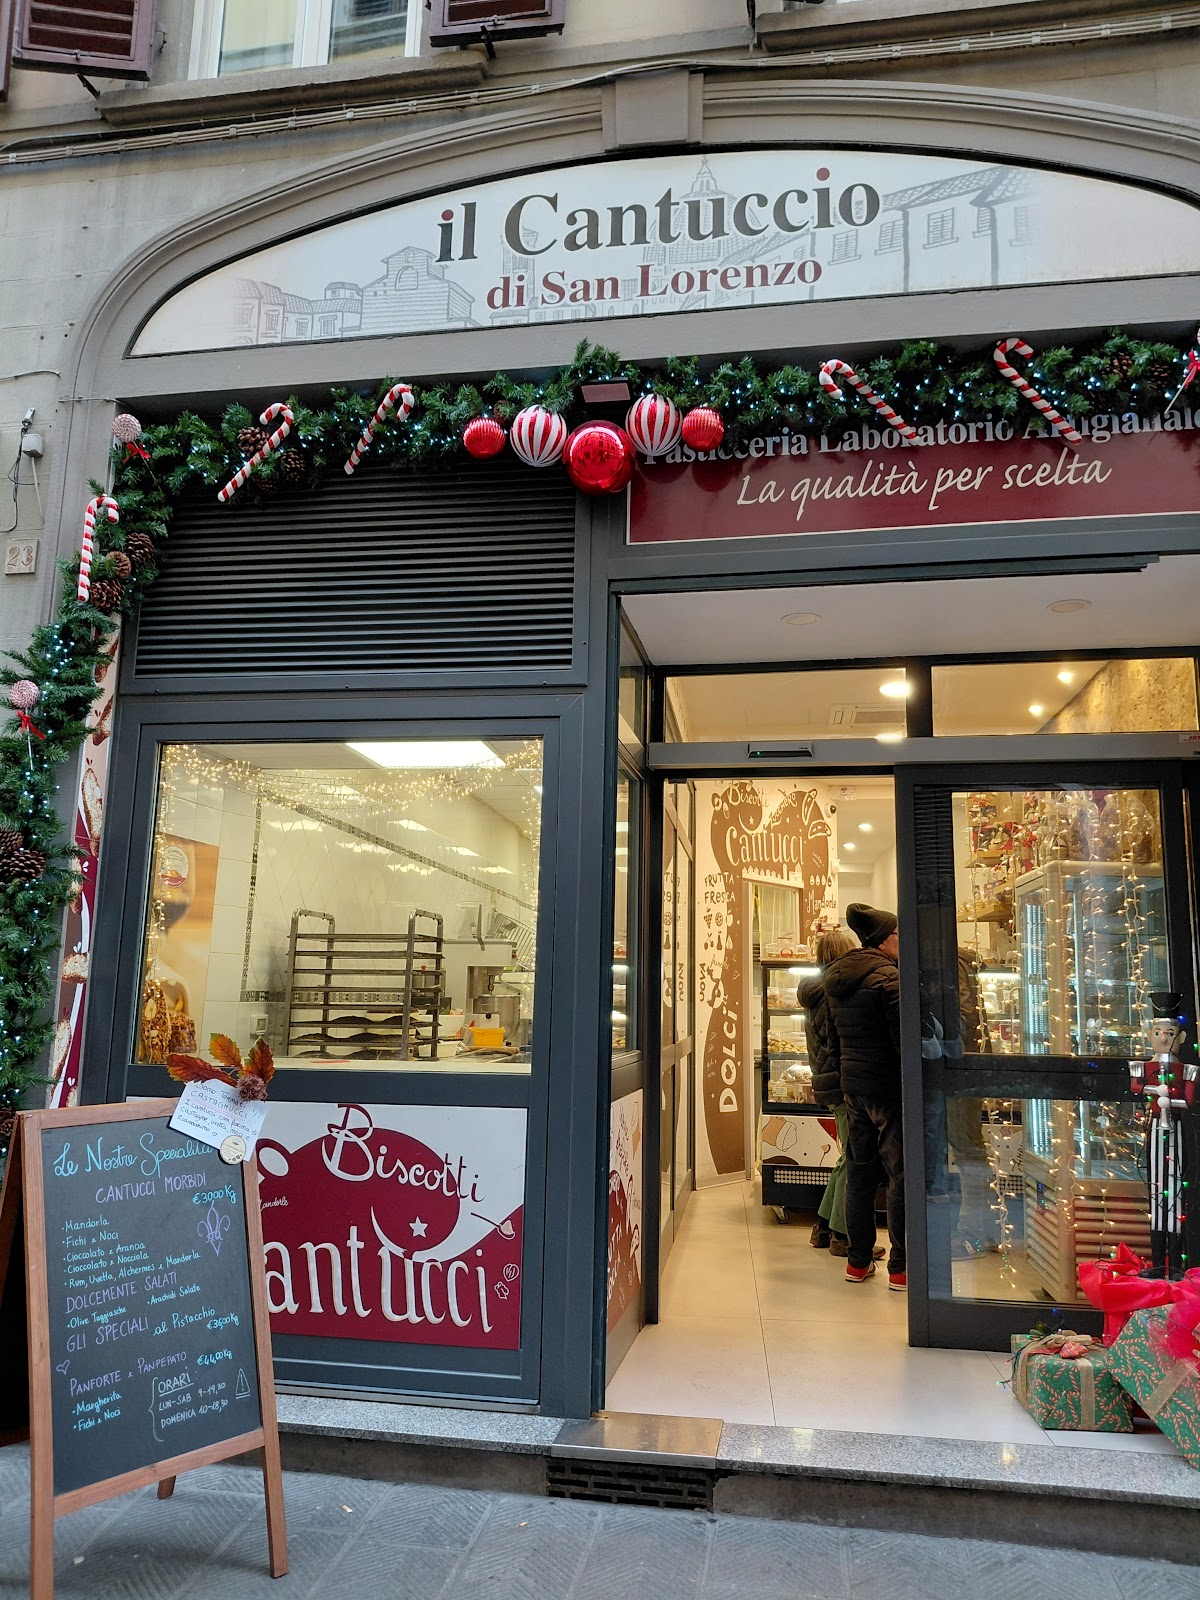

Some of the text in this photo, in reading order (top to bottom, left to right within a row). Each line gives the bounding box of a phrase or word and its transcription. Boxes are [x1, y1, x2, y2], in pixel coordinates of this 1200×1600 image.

[435, 167, 881, 263] il Cantuccio
[486, 259, 823, 310] di San Lorenzo
[736, 446, 1112, 521] La qualità per scelta
[7, 545, 33, 567] 23
[725, 824, 804, 866] Cantucci
[704, 872, 735, 888] FRUTTA
[806, 888, 837, 914] Mandorle
[719, 1006, 738, 1113] DOLCI
[53, 1142, 79, 1176] Le
[85, 1136, 138, 1172] Nostre
[321, 1103, 485, 1202] Biscotti
[95, 1170, 207, 1203] CANTUCCI MORBIDI
[260, 1195, 289, 1211] andorle
[65, 1214, 110, 1233] Mandorla
[66, 1235, 87, 1248] Fichi
[99, 1230, 119, 1241] Noci
[66, 1246, 105, 1262] Cioccolato
[67, 1258, 107, 1274] Cioccolato
[117, 1250, 150, 1265] Nocciola
[118, 1263, 156, 1279] Alchermes
[165, 1249, 201, 1268] Mandorla
[65, 1269, 177, 1314] DOLCEMENTE SALATI
[263, 1225, 494, 1334] antucci
[66, 1305, 216, 1352] GLI SPECIALI al Pistacchio
[70, 1316, 90, 1329] Olive
[70, 1370, 121, 1397] PANFORTE
[137, 1351, 187, 1374] PANPEPATO
[76, 1391, 122, 1415] Margherita
[160, 1407, 196, 1429] DOMENICA
[78, 1417, 96, 1431] Fichi
[104, 1407, 121, 1420] Noci
